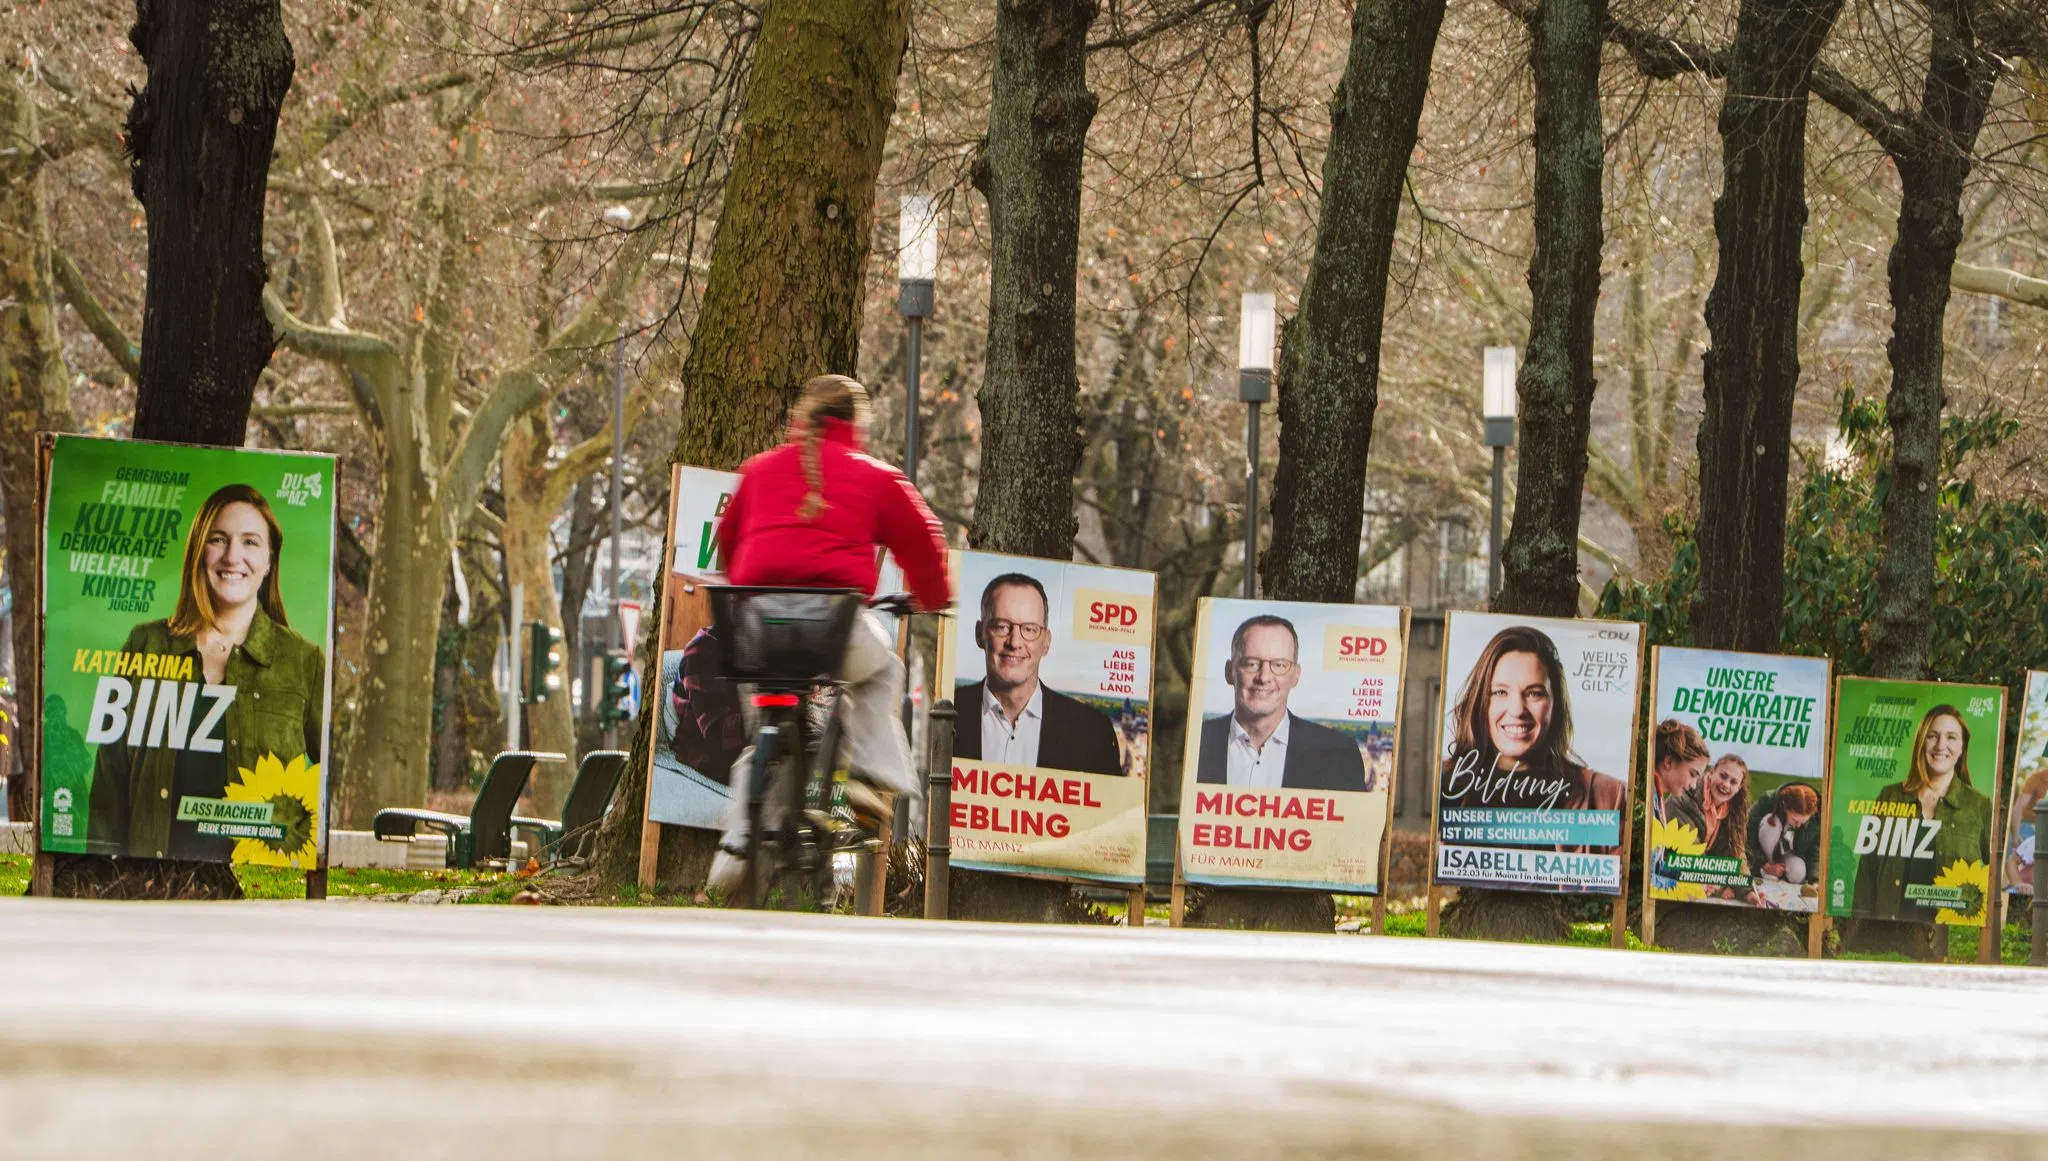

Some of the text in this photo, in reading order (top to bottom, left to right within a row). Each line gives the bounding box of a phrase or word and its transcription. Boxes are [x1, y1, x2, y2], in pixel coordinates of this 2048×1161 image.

[116, 467, 190, 486] GEMEINSAM
[281, 472, 304, 490] DU
[100, 480, 187, 509] FAMILIE
[288, 490, 309, 507] MZ
[73, 502, 182, 540] KULTUR
[59, 532, 169, 559] DEMOKRATIE
[69, 552, 153, 577] VIELFALT
[81, 574, 156, 601] KINDER
[108, 599, 150, 613] JUGEND
[1089, 601, 1138, 627] SPD
[1597, 630, 1630, 641] CDU
[1339, 636, 1387, 656] SPD
[72, 648, 194, 681] KATHARINA
[1112, 650, 1136, 661] AUS
[1582, 650, 1628, 665] WEIL'S
[1103, 659, 1135, 672] LIEBE
[1572, 663, 1629, 680] JETZT
[1109, 671, 1134, 683] ZUM
[1361, 678, 1384, 687] AUS
[1581, 679, 1612, 693] GILT
[1706, 667, 1778, 692] UNSERE
[1099, 681, 1134, 695] LAND.
[1352, 687, 1383, 697] LIEBE
[1357, 698, 1382, 707] ZUM
[1672, 687, 1817, 723] DEMOKRATIE
[1867, 703, 1916, 719] FAMILIE
[85, 675, 238, 753] BINZ
[1347, 708, 1381, 718] LAND.
[1697, 716, 1811, 749] SCHÜTZEN
[1852, 716, 1912, 737] KULTUR
[1844, 733, 1904, 748] DEMOKRATIE
[1849, 744, 1896, 760] VIELFALT
[1856, 757, 1898, 772] KINDER
[952, 767, 1101, 808] MICHAEL
[1442, 749, 1571, 816] Bildung.
[183, 801, 268, 821] LASS MACHEN!
[1195, 791, 1345, 822] MICHAEL
[1848, 800, 1917, 818] KATHARINA
[950, 802, 1070, 839] EBLING
[1442, 809, 1616, 826] UNSERE WICHTIGSTE BANK
[197, 821, 283, 839] BEIDE STIMMEN GRÜN.
[1192, 823, 1312, 852] EBLING
[1442, 826, 1569, 842] IST DIE SCHULBANK!
[1853, 815, 1943, 860] BINZ
[949, 836, 1024, 853] FÜR MAINZ
[1190, 852, 1264, 869] FÜR MAINZ
[1443, 849, 1615, 878] ISABELL RAHMS
[1667, 855, 1738, 873] LASS MACHEN!
[1441, 869, 1455, 877] am
[1482, 870, 1493, 879] für
[1495, 870, 1518, 880] Mainz
[1524, 871, 1532, 881] in
[1533, 873, 1548, 881] den
[1549, 873, 1582, 886] Landtag
[1583, 876, 1616, 886] wählen!
[1679, 871, 1750, 887] ZWEITSTIMME GRÜN.
[1908, 886, 1959, 899] LASS MACHEN!
